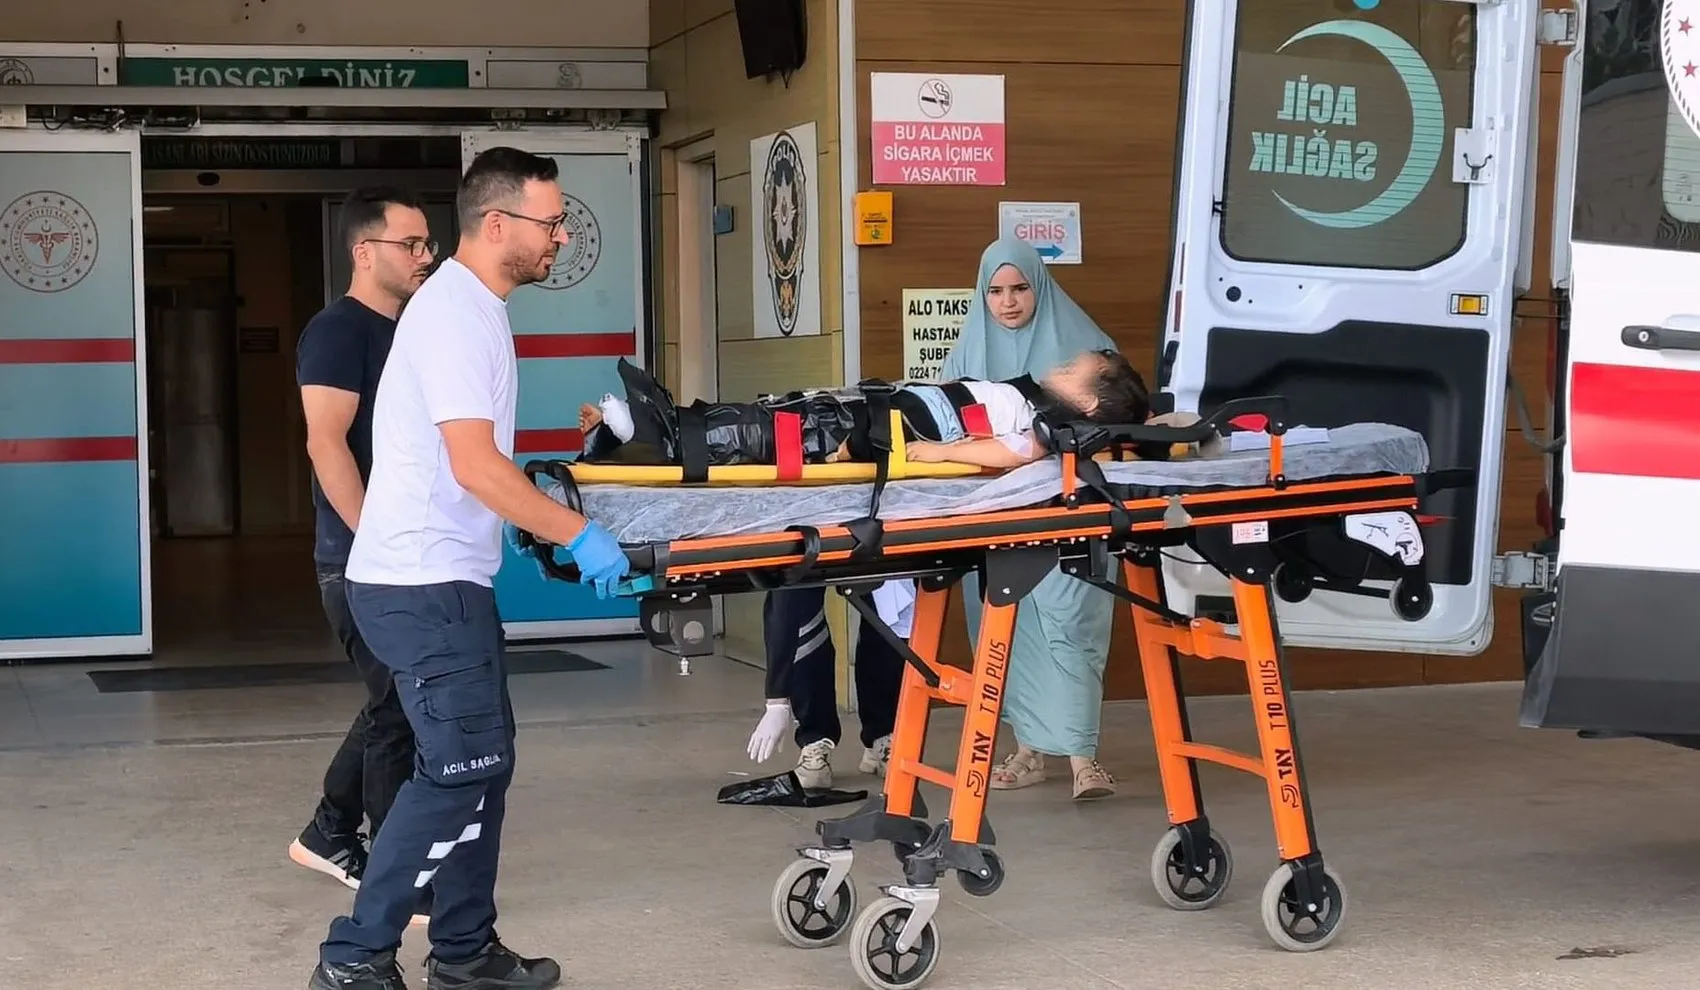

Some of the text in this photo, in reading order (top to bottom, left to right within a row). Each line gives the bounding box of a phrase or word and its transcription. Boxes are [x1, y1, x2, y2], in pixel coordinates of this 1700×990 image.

[895, 125, 984, 141] BU ALANDA
[884, 142, 994, 166] SİGARA İÇMEK
[901, 166, 978, 182] YASAKTIR
[1014, 220, 1065, 244] GİRİŞ
[908, 300, 933, 316] ALO
[909, 366, 929, 379] 0224
[1258, 660, 1279, 696] PLUS
[971, 730, 991, 764] TAY
[985, 638, 1006, 680] PLUS
[1275, 748, 1292, 780] TAY
